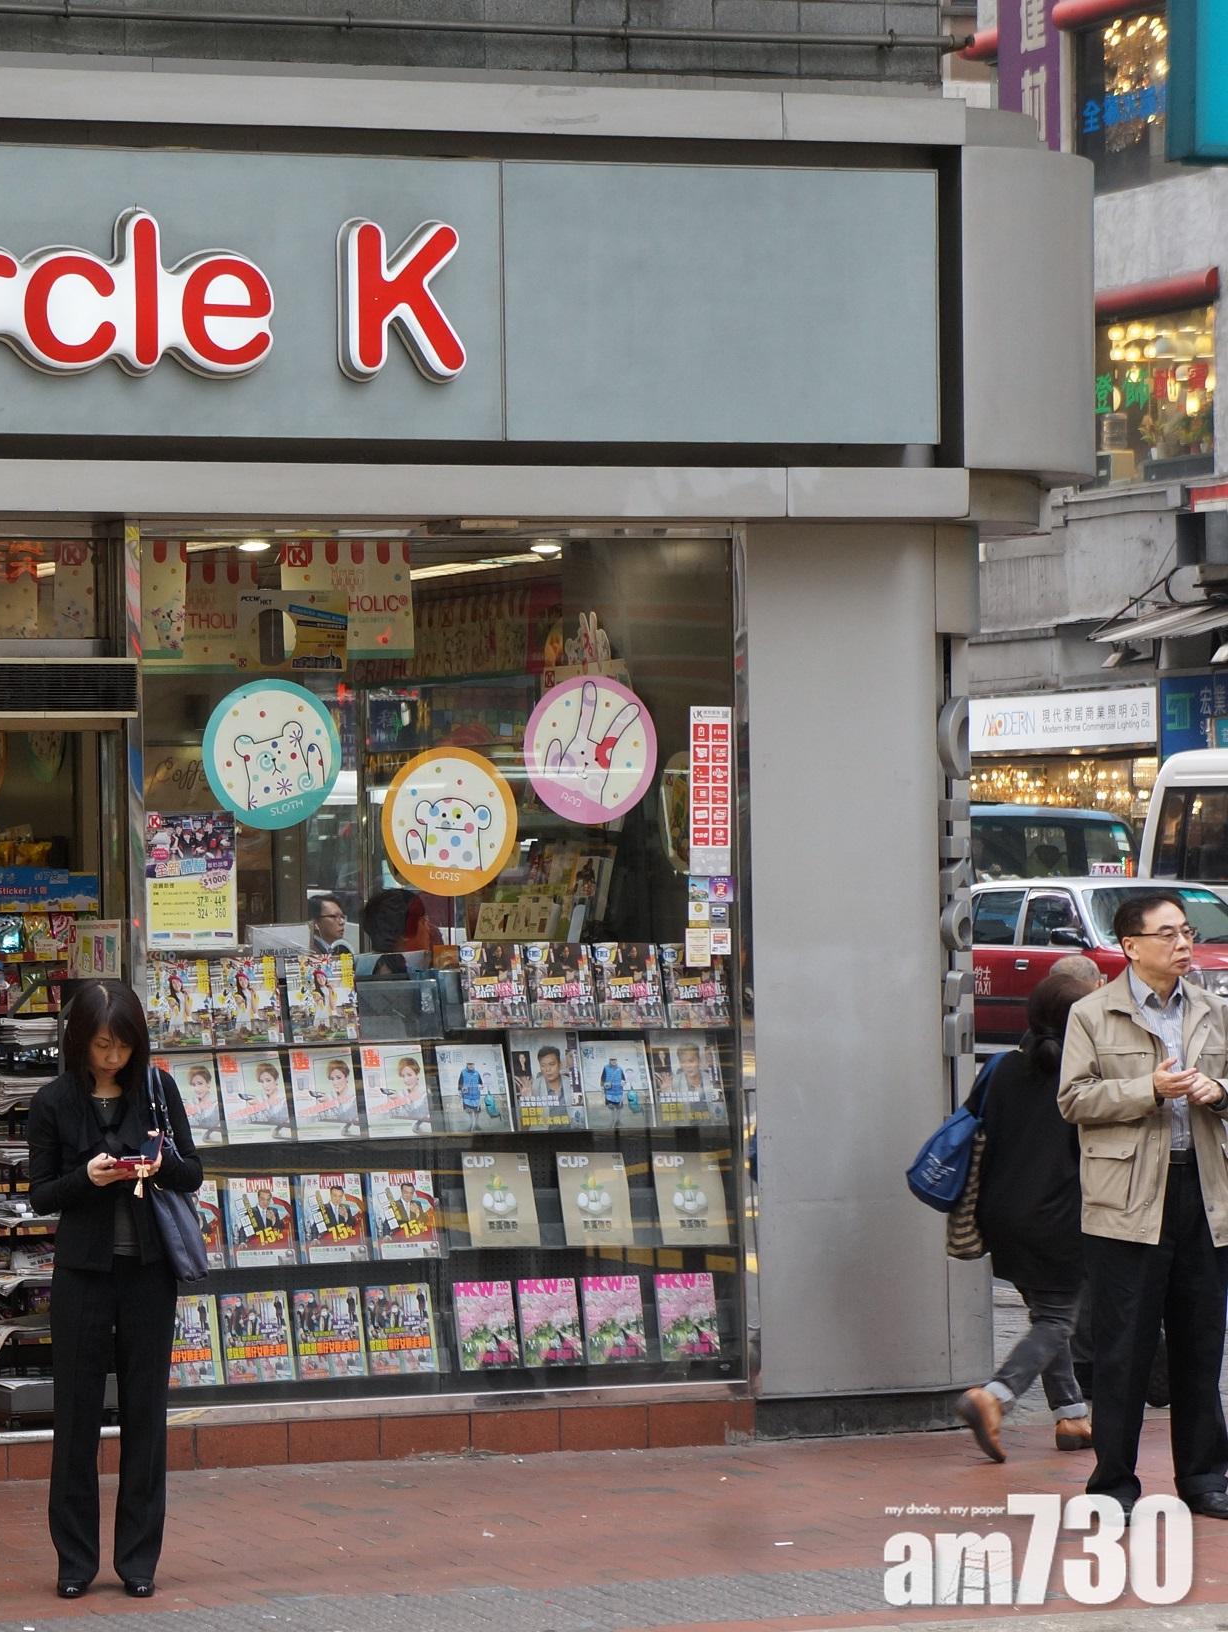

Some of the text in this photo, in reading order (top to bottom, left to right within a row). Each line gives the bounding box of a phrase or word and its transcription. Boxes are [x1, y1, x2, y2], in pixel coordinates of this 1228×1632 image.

[357, 223, 466, 371] K
[1042, 702, 1151, 723] 現代家居商業照明公司
[270, 800, 304, 816] SLOTH
[429, 871, 461, 882] LORIS
[974, 980, 991, 996] TAXI
[463, 1155, 495, 1168] CUP
[557, 1155, 589, 1168] CUP
[653, 1155, 685, 1168] CUP
[256, 1226, 283, 1246] 7.5%
[328, 1223, 356, 1243] 7.5%
[400, 1220, 429, 1239] 7.5%
[455, 1282, 494, 1297] HKW
[518, 1279, 558, 1295] HKW
[581, 1276, 621, 1292] HKW
[654, 1274, 696, 1289] HKW
